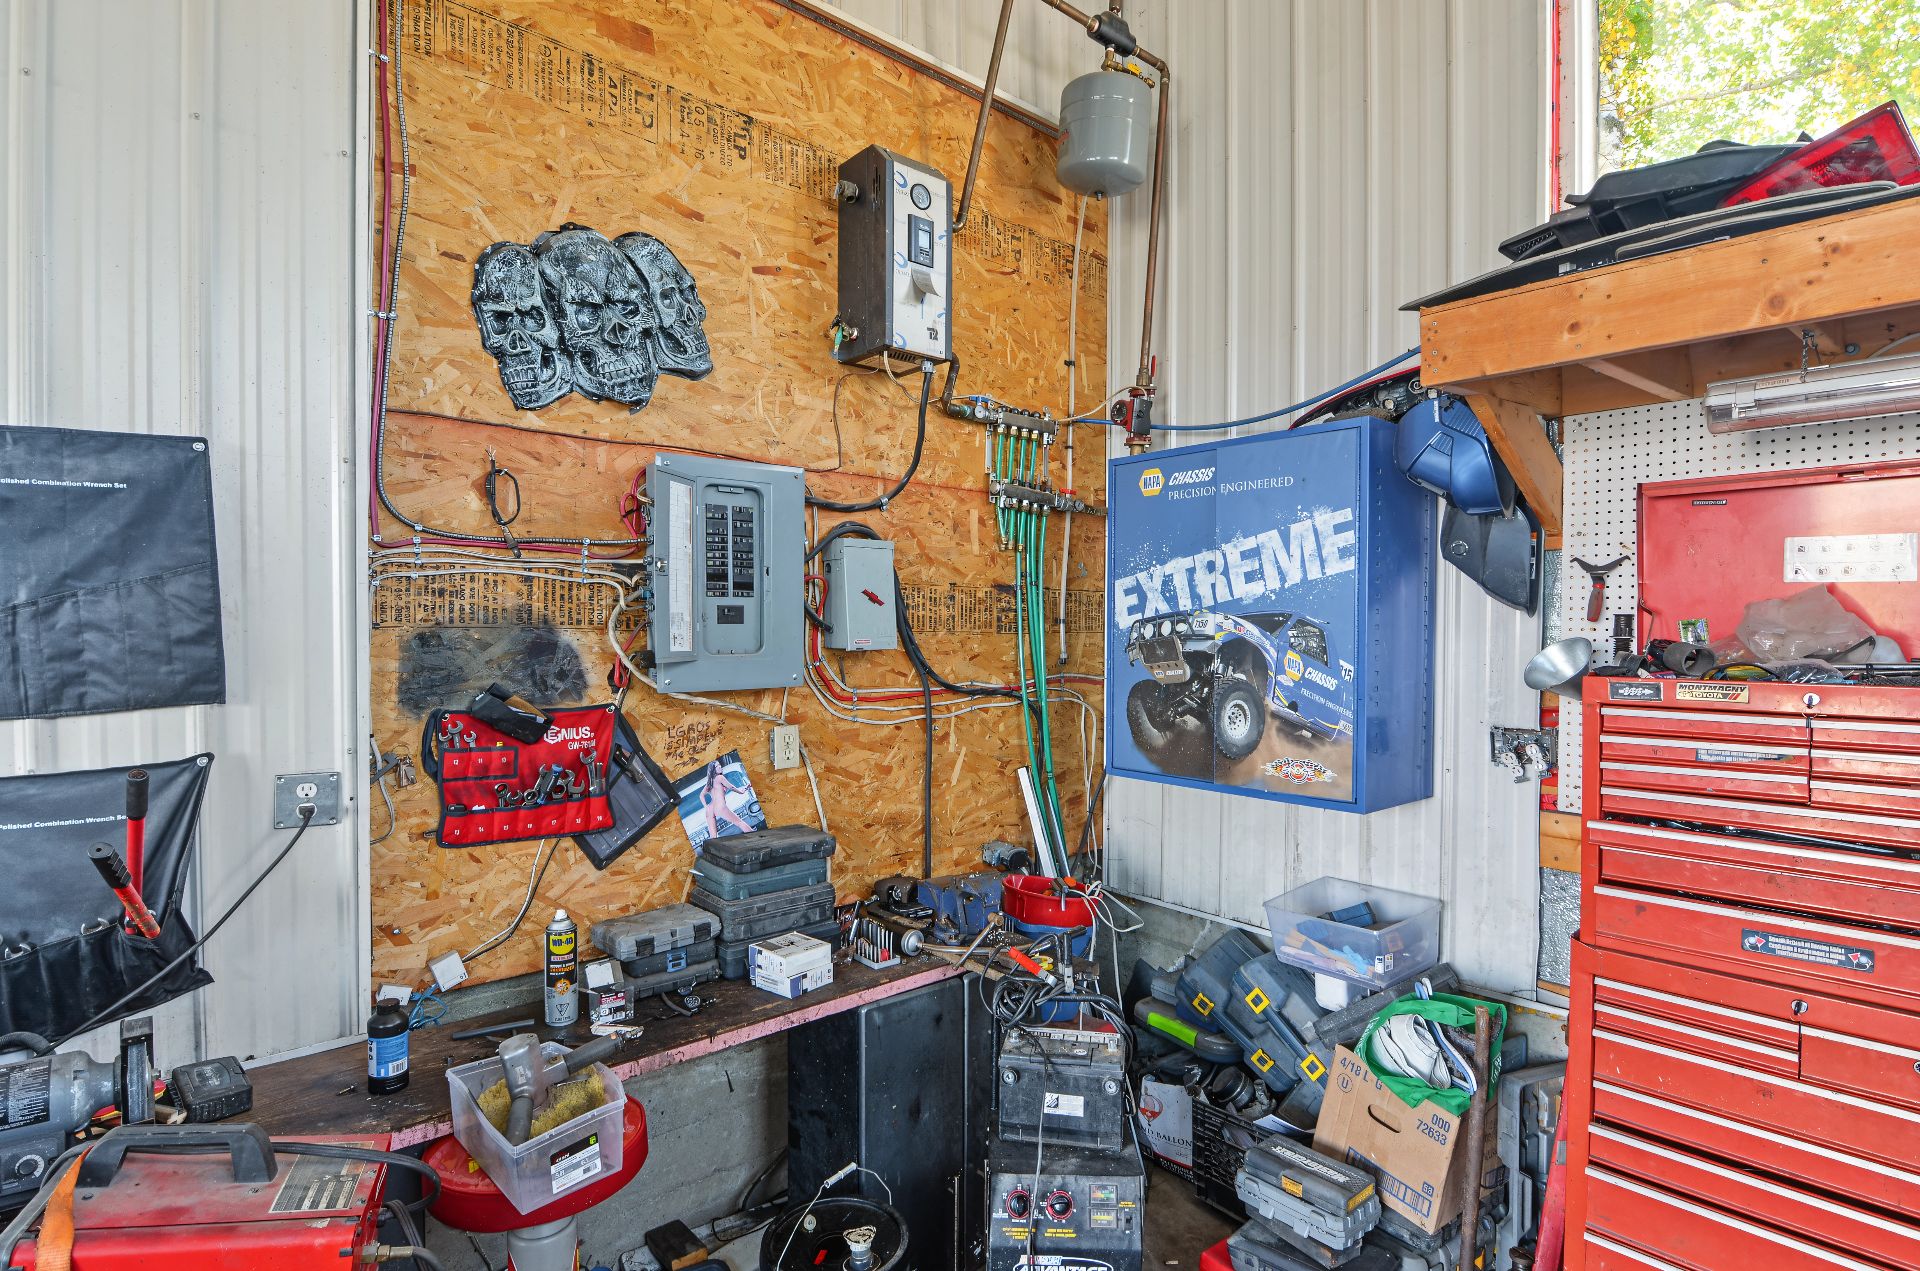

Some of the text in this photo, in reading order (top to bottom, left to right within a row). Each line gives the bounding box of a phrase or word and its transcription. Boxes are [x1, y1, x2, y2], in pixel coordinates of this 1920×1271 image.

[608, 75, 618, 117] APA
[634, 90, 655, 129] LP
[733, 131, 748, 161] LP
[1011, 234, 1022, 263] LP
[0, 477, 30, 485] olished
[31, 478, 82, 488] Combination
[83, 481, 113, 489] Wrench
[1143, 467, 1216, 490] NAPA CHASSIS
[1220, 476, 1294, 494] ENGINEERED
[1114, 507, 1356, 630] EXTREME
[1304, 667, 1338, 691] CHASSIS
[1678, 684, 1747, 693] MONTMAGNY
[1691, 691, 1724, 699] TOYOTA
[34, 819, 85, 828] Combination
[86, 815, 115, 824] Wrench
[116, 813, 128, 821] Se
[551, 937, 574, 947] WD-40
[1340, 1057, 1361, 1076] 4/18
[1416, 1118, 1448, 1146] 72633
[1431, 1113, 1451, 1133] 000
[1156, 1131, 1193, 1147] BALLON
